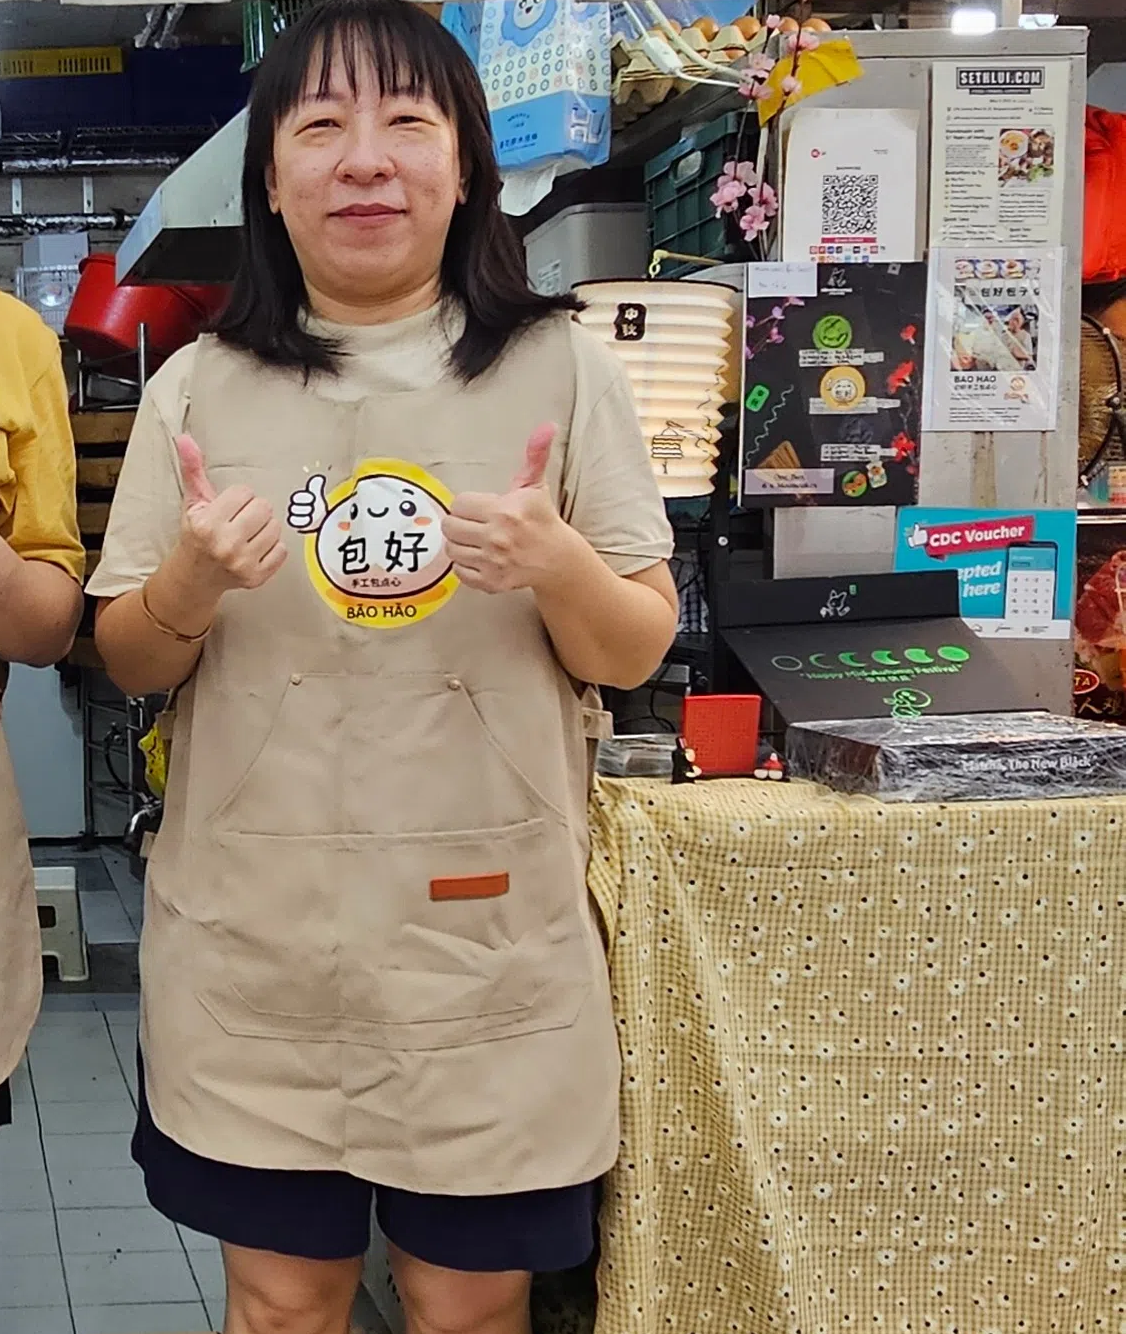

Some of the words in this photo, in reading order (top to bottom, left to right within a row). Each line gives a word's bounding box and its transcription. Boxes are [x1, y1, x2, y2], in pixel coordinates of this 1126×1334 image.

[960, 71, 1041, 85] SETHLUI.COM
[929, 531, 962, 547] CDC
[964, 525, 1026, 543] Voucher
[337, 530, 429, 575] 包好
[962, 581, 1001, 598] here
